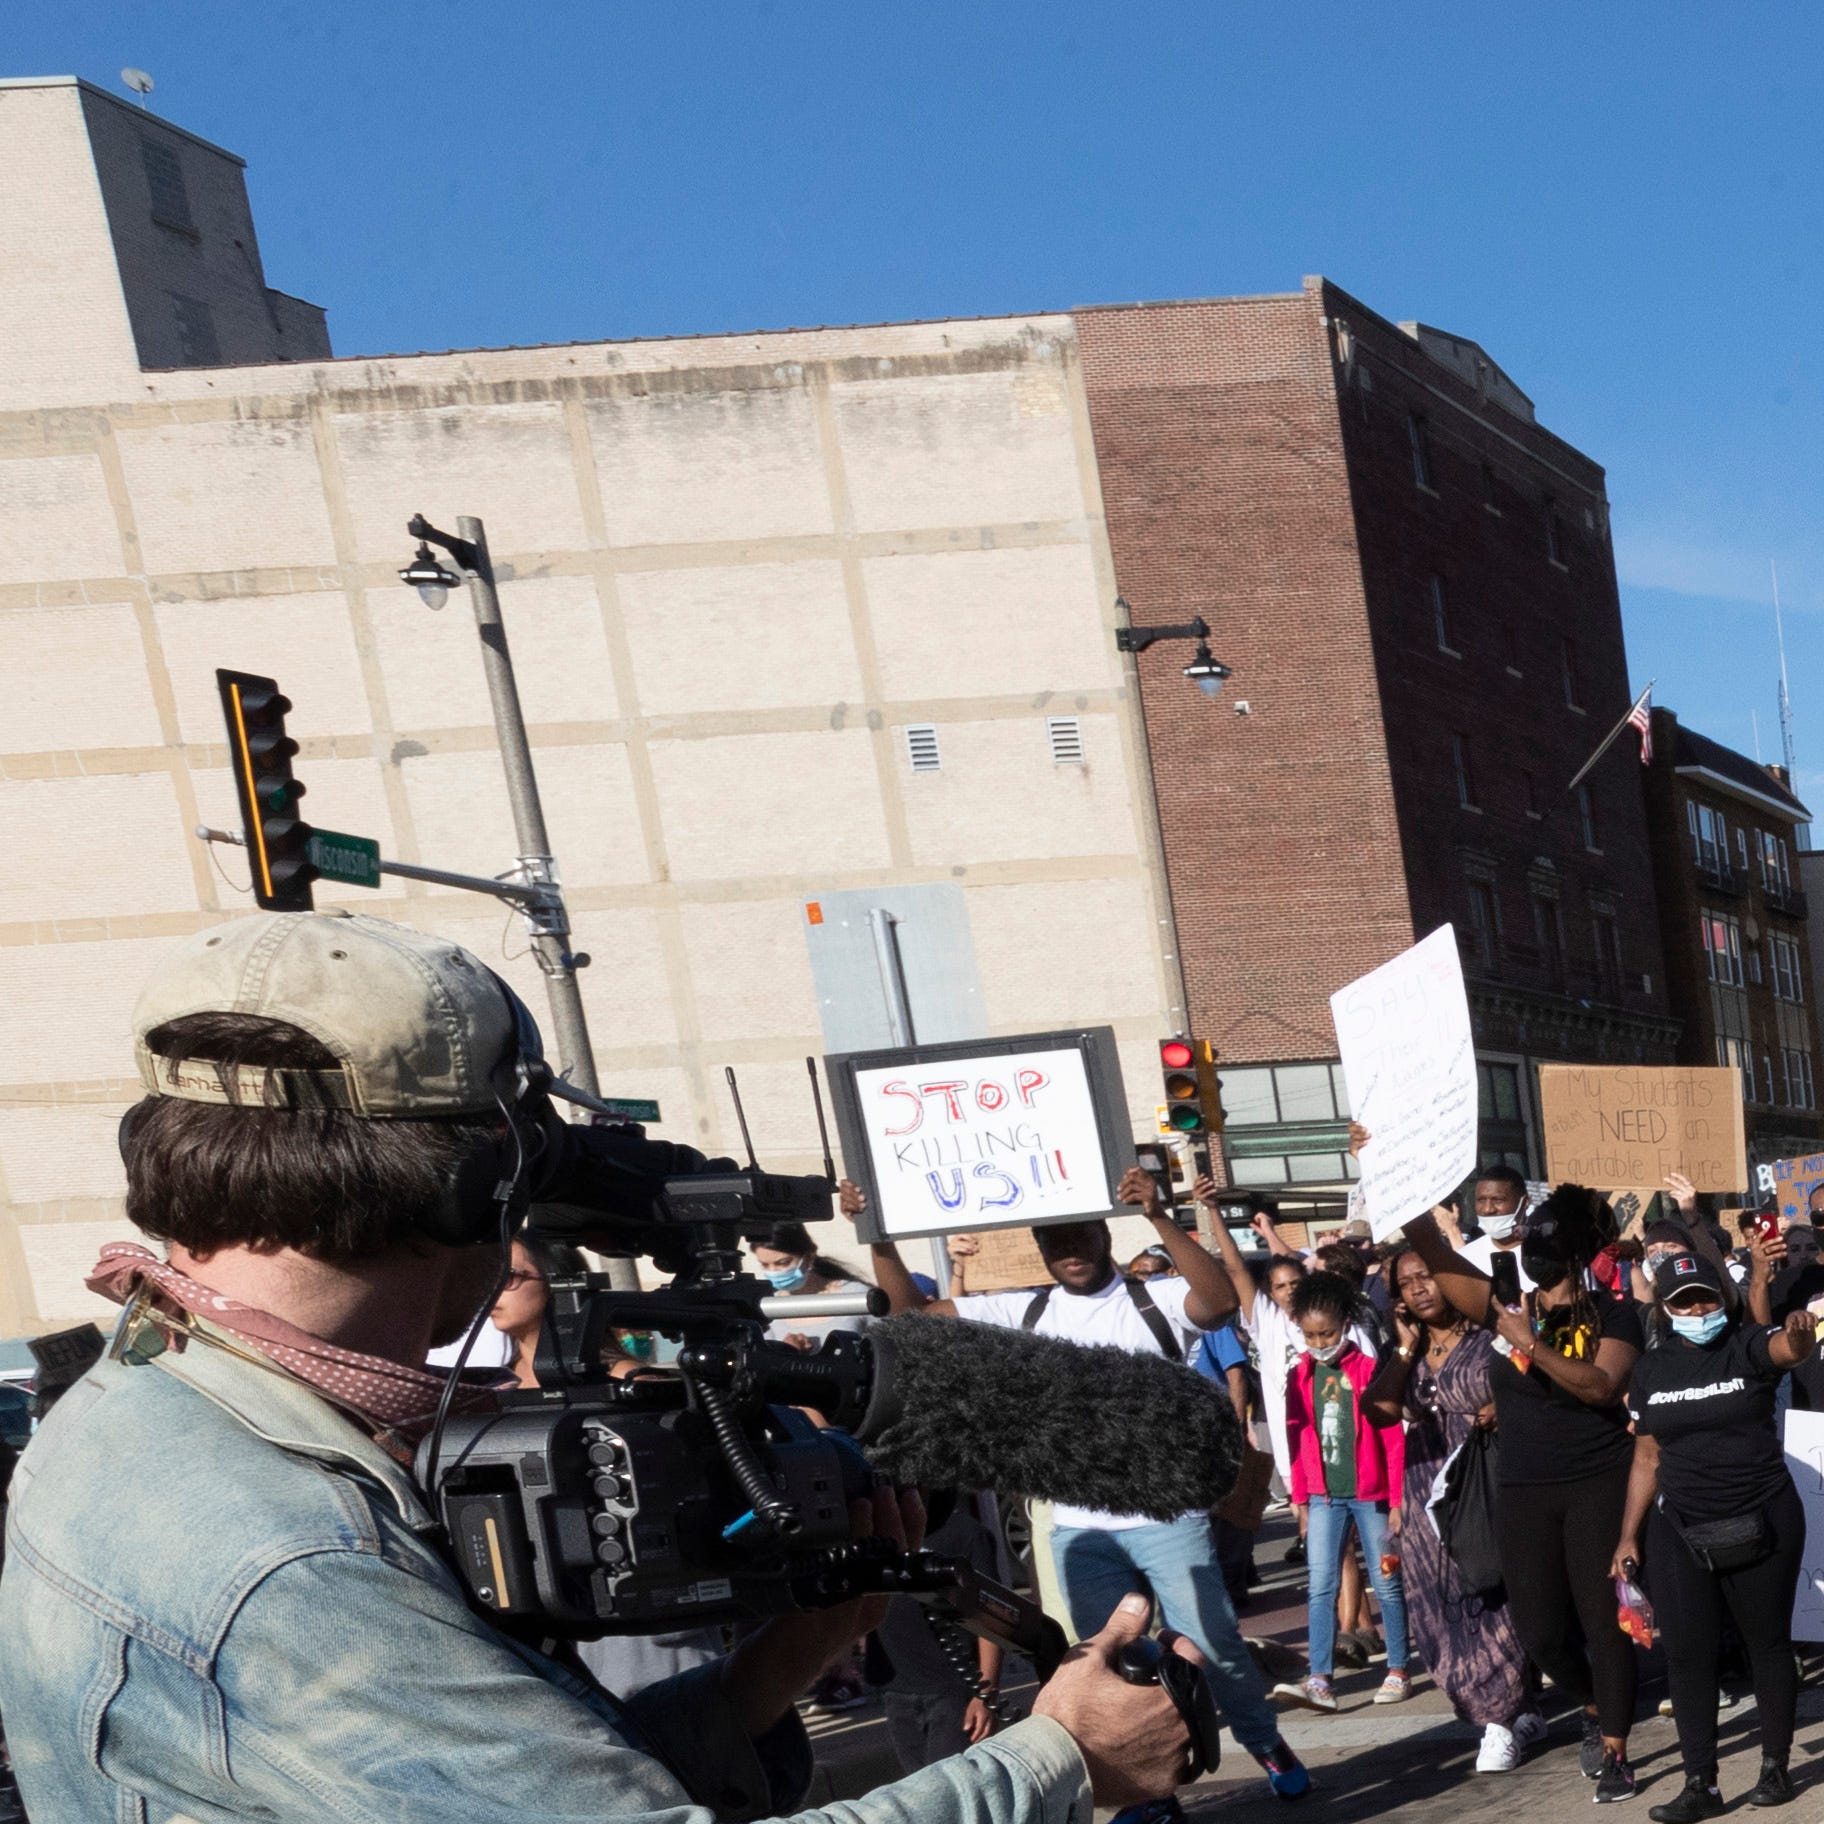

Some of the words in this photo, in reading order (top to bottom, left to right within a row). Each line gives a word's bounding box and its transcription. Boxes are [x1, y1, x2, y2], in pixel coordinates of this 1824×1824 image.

[166, 1072, 264, 1094] carhatt
[881, 1067, 1051, 1136] STOP
[1566, 1068, 1601, 1113] My
[1614, 1067, 1714, 1109] Students
[893, 1123, 1042, 1172] KILLING
[1600, 1108, 1668, 1145] NEED
[1684, 1117, 1711, 1142] an
[1550, 1143, 1645, 1185] Equitable
[1230, 1206, 1243, 1217] St
